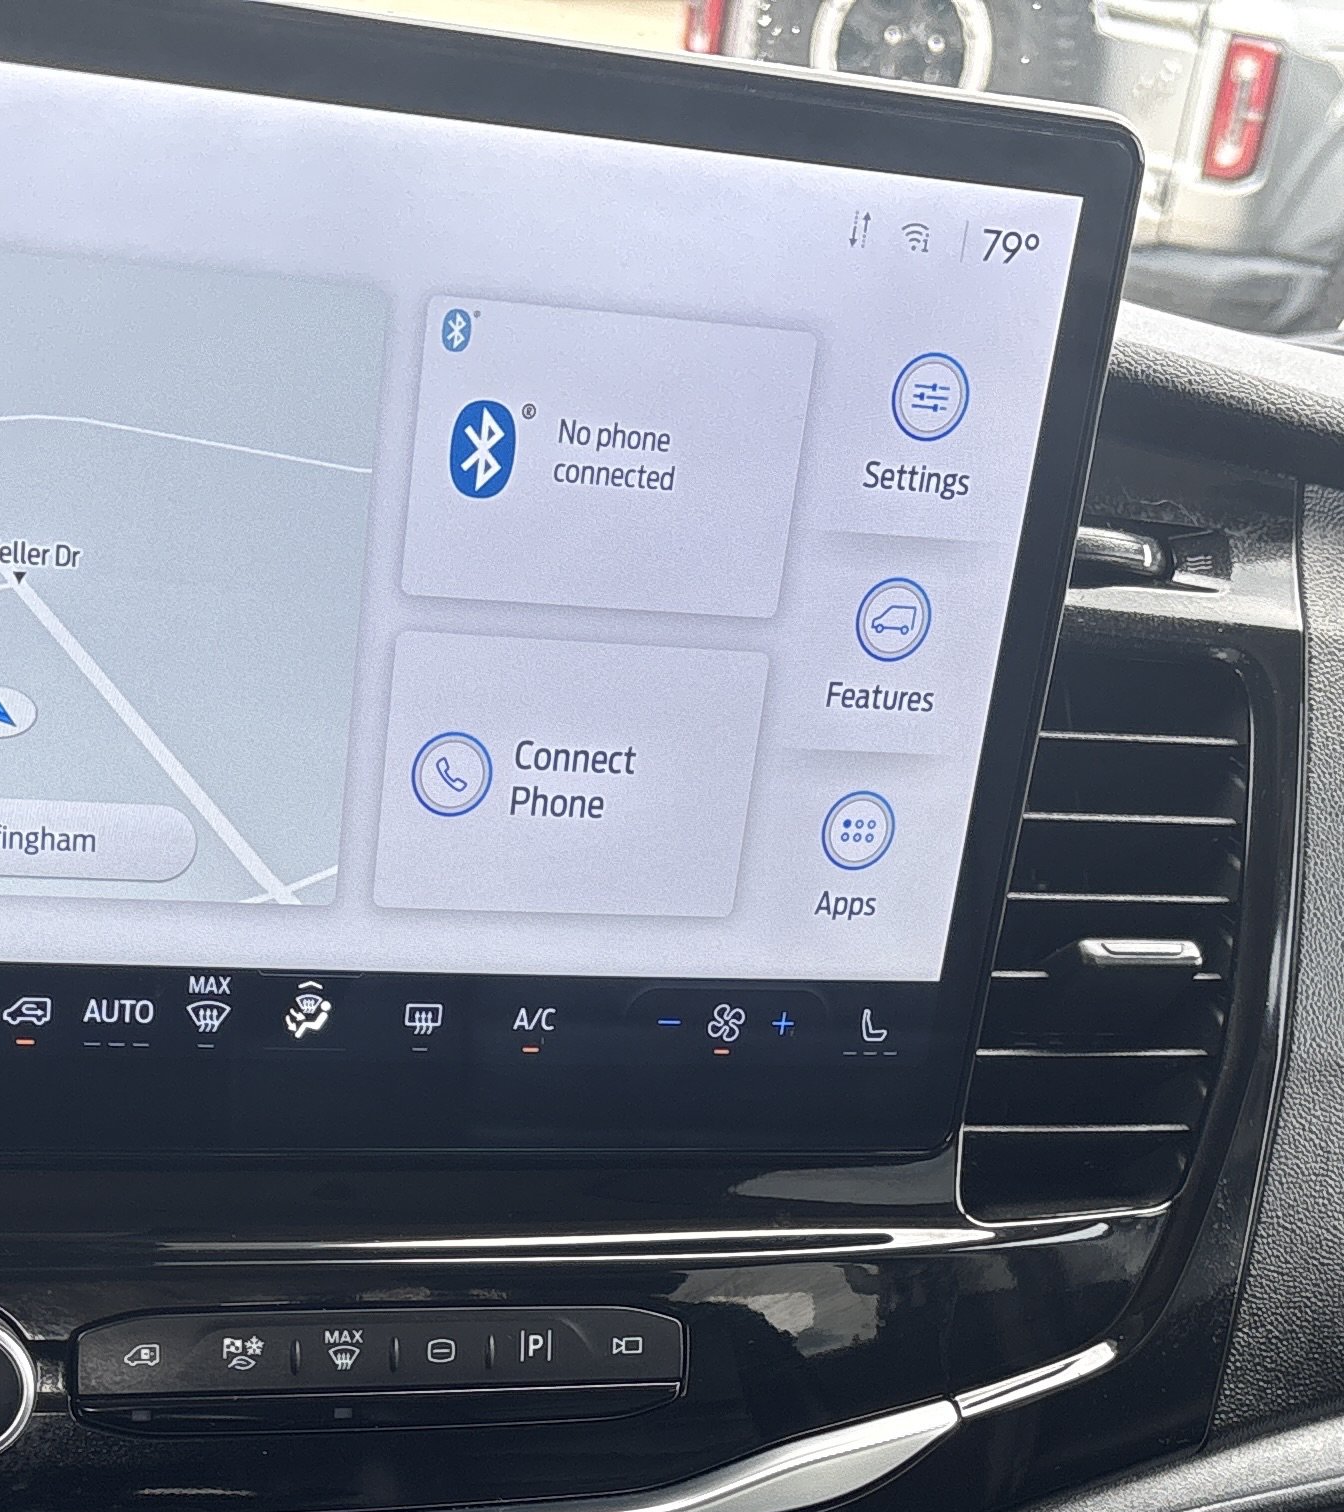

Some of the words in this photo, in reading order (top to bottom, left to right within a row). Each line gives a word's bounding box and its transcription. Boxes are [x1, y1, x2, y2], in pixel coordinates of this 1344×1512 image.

[558, 418, 591, 446] No
[595, 422, 671, 453] phone
[553, 463, 676, 491] connected
[862, 461, 970, 498] Settings
[55, 544, 81, 568] Dr
[825, 681, 935, 713] Features
[515, 740, 637, 775] Connect
[510, 785, 604, 819] Phone
[814, 890, 877, 921] Apps
[188, 975, 231, 995] MAX
[83, 998, 154, 1024] AUTO
[512, 1007, 556, 1031] A/C
[324, 1329, 363, 1344] MAX
[528, 1334, 544, 1357] P
